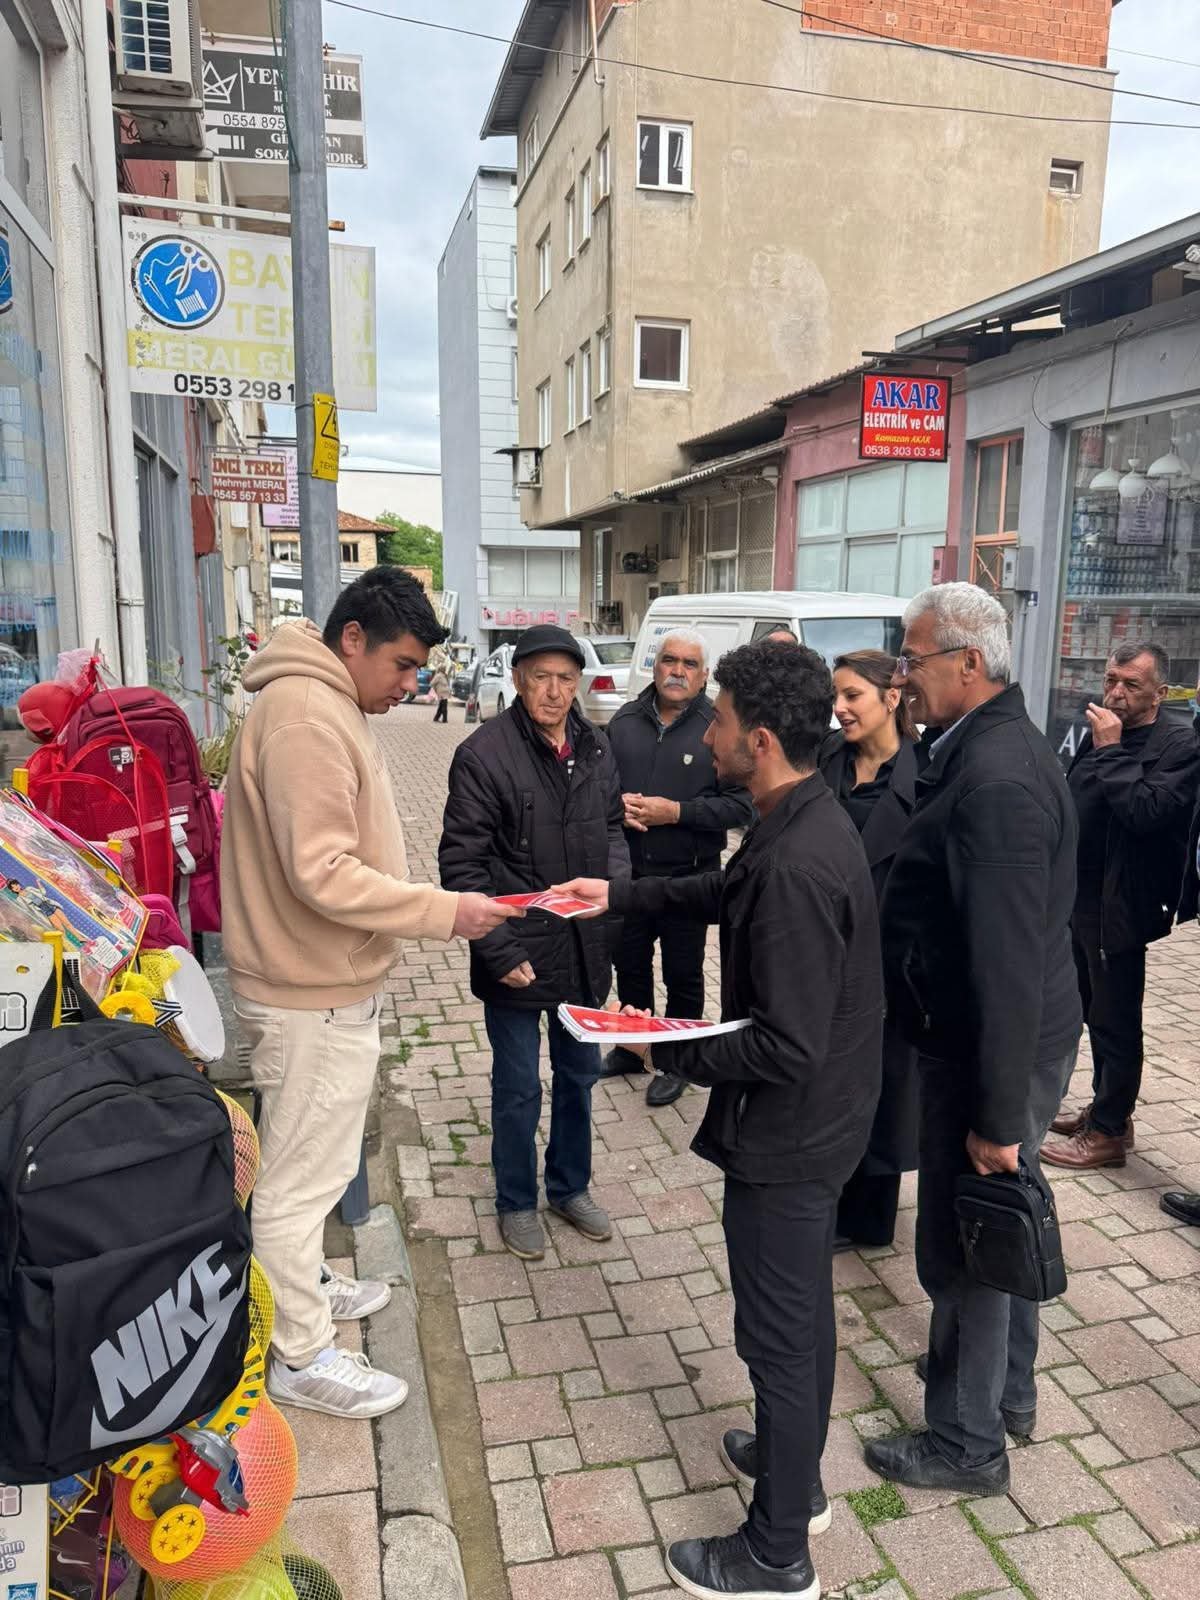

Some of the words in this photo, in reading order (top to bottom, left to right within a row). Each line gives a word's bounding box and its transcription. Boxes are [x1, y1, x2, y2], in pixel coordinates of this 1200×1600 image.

[223, 114, 255, 127] 0554
[261, 116, 285, 129] 895
[174, 373, 232, 396] 0553
[238, 379, 282, 401] 298
[871, 380, 941, 410] AKAR
[864, 410, 908, 429] ELEKTRİK
[910, 418, 921, 430] ve
[923, 415, 945, 431] CAM
[865, 445, 890, 455] 0538
[893, 446, 911, 456] 303
[914, 447, 926, 457] 03
[253, 480, 285, 490] MERAL
[214, 490, 237, 500] 0545
[260, 492, 272, 502] 13
[273, 493, 285, 503] 33
[91, 1240, 235, 1422] NIKE
